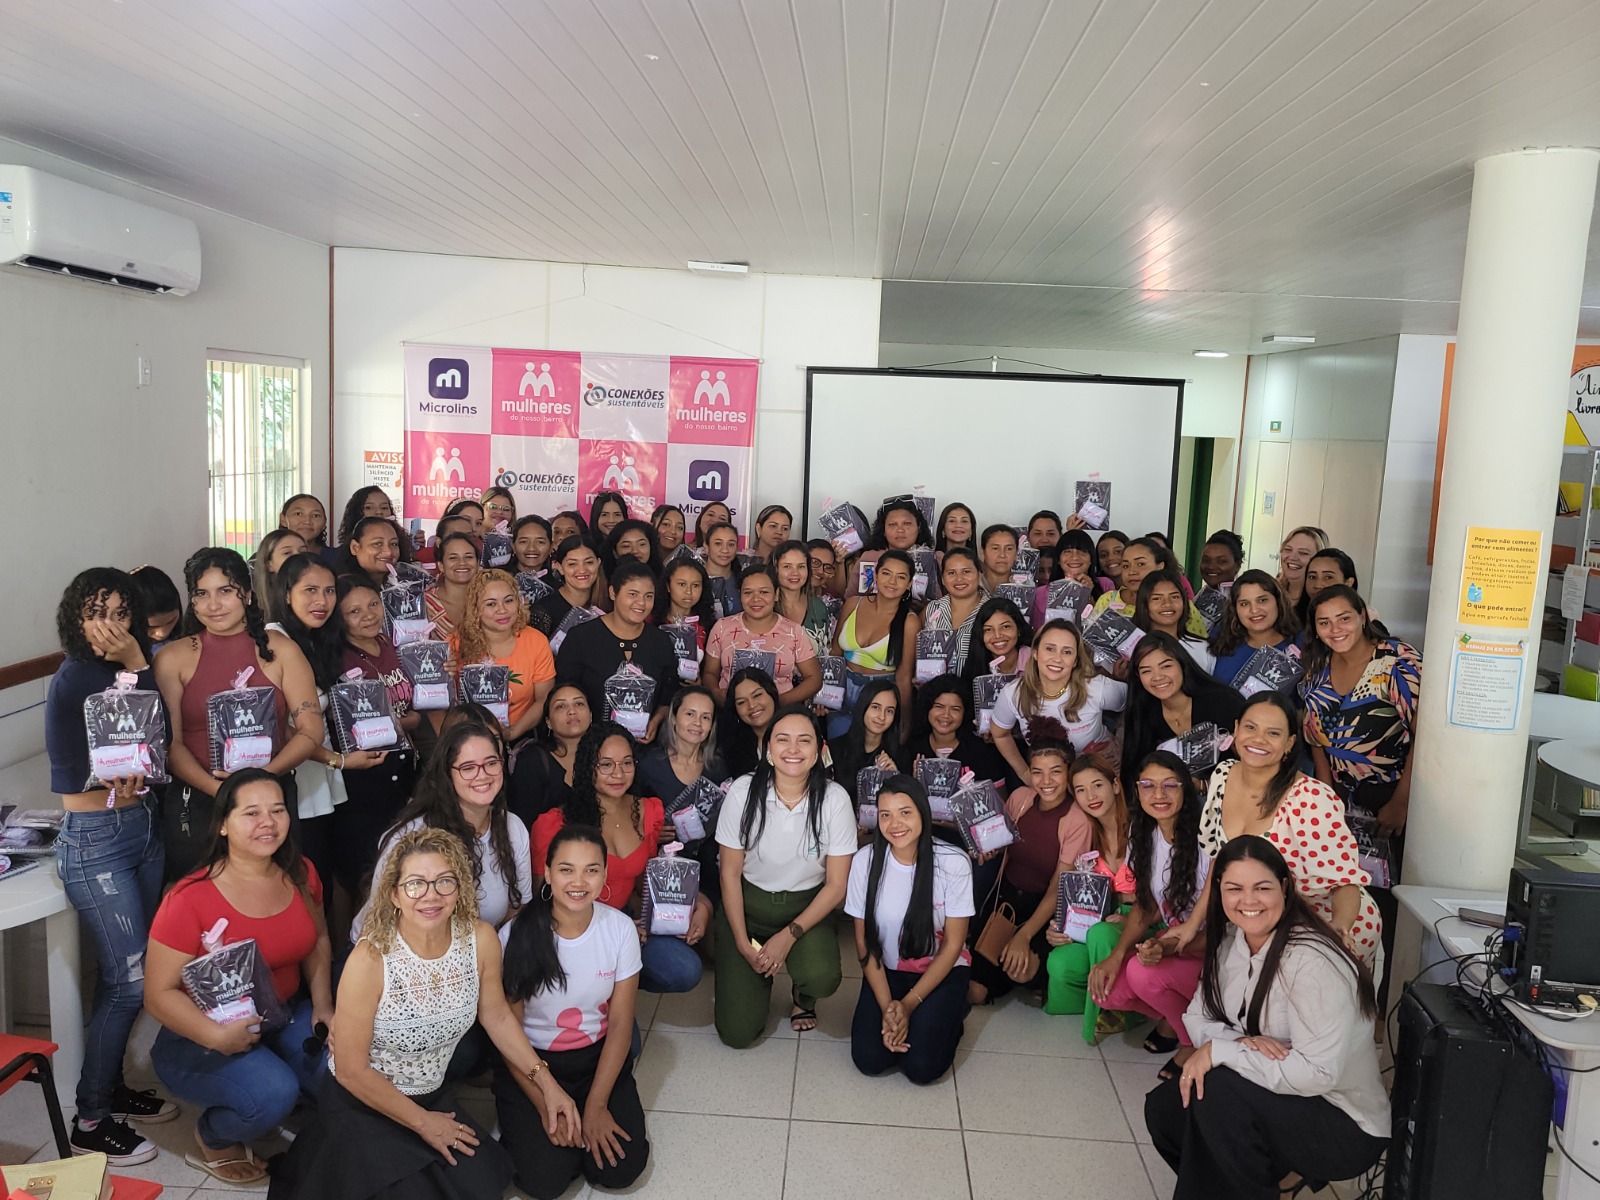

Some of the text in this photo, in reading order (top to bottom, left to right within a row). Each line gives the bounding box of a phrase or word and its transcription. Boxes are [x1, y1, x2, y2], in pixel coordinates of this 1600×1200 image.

[608, 388, 664, 400] CONEXÕES
[419, 402, 477, 414] Microlins
[501, 399, 571, 414] mulheres
[607, 400, 664, 408] sustentáveis
[676, 407, 746, 423] mulheres
[519, 472, 575, 484] CONEXÕES
[412, 483, 482, 499] mulheres
[519, 484, 574, 493] sustentáveis
[229, 724, 263, 735] mulheres
[105, 756, 134, 765] mulheres
[216, 982, 254, 1002] mulheres
